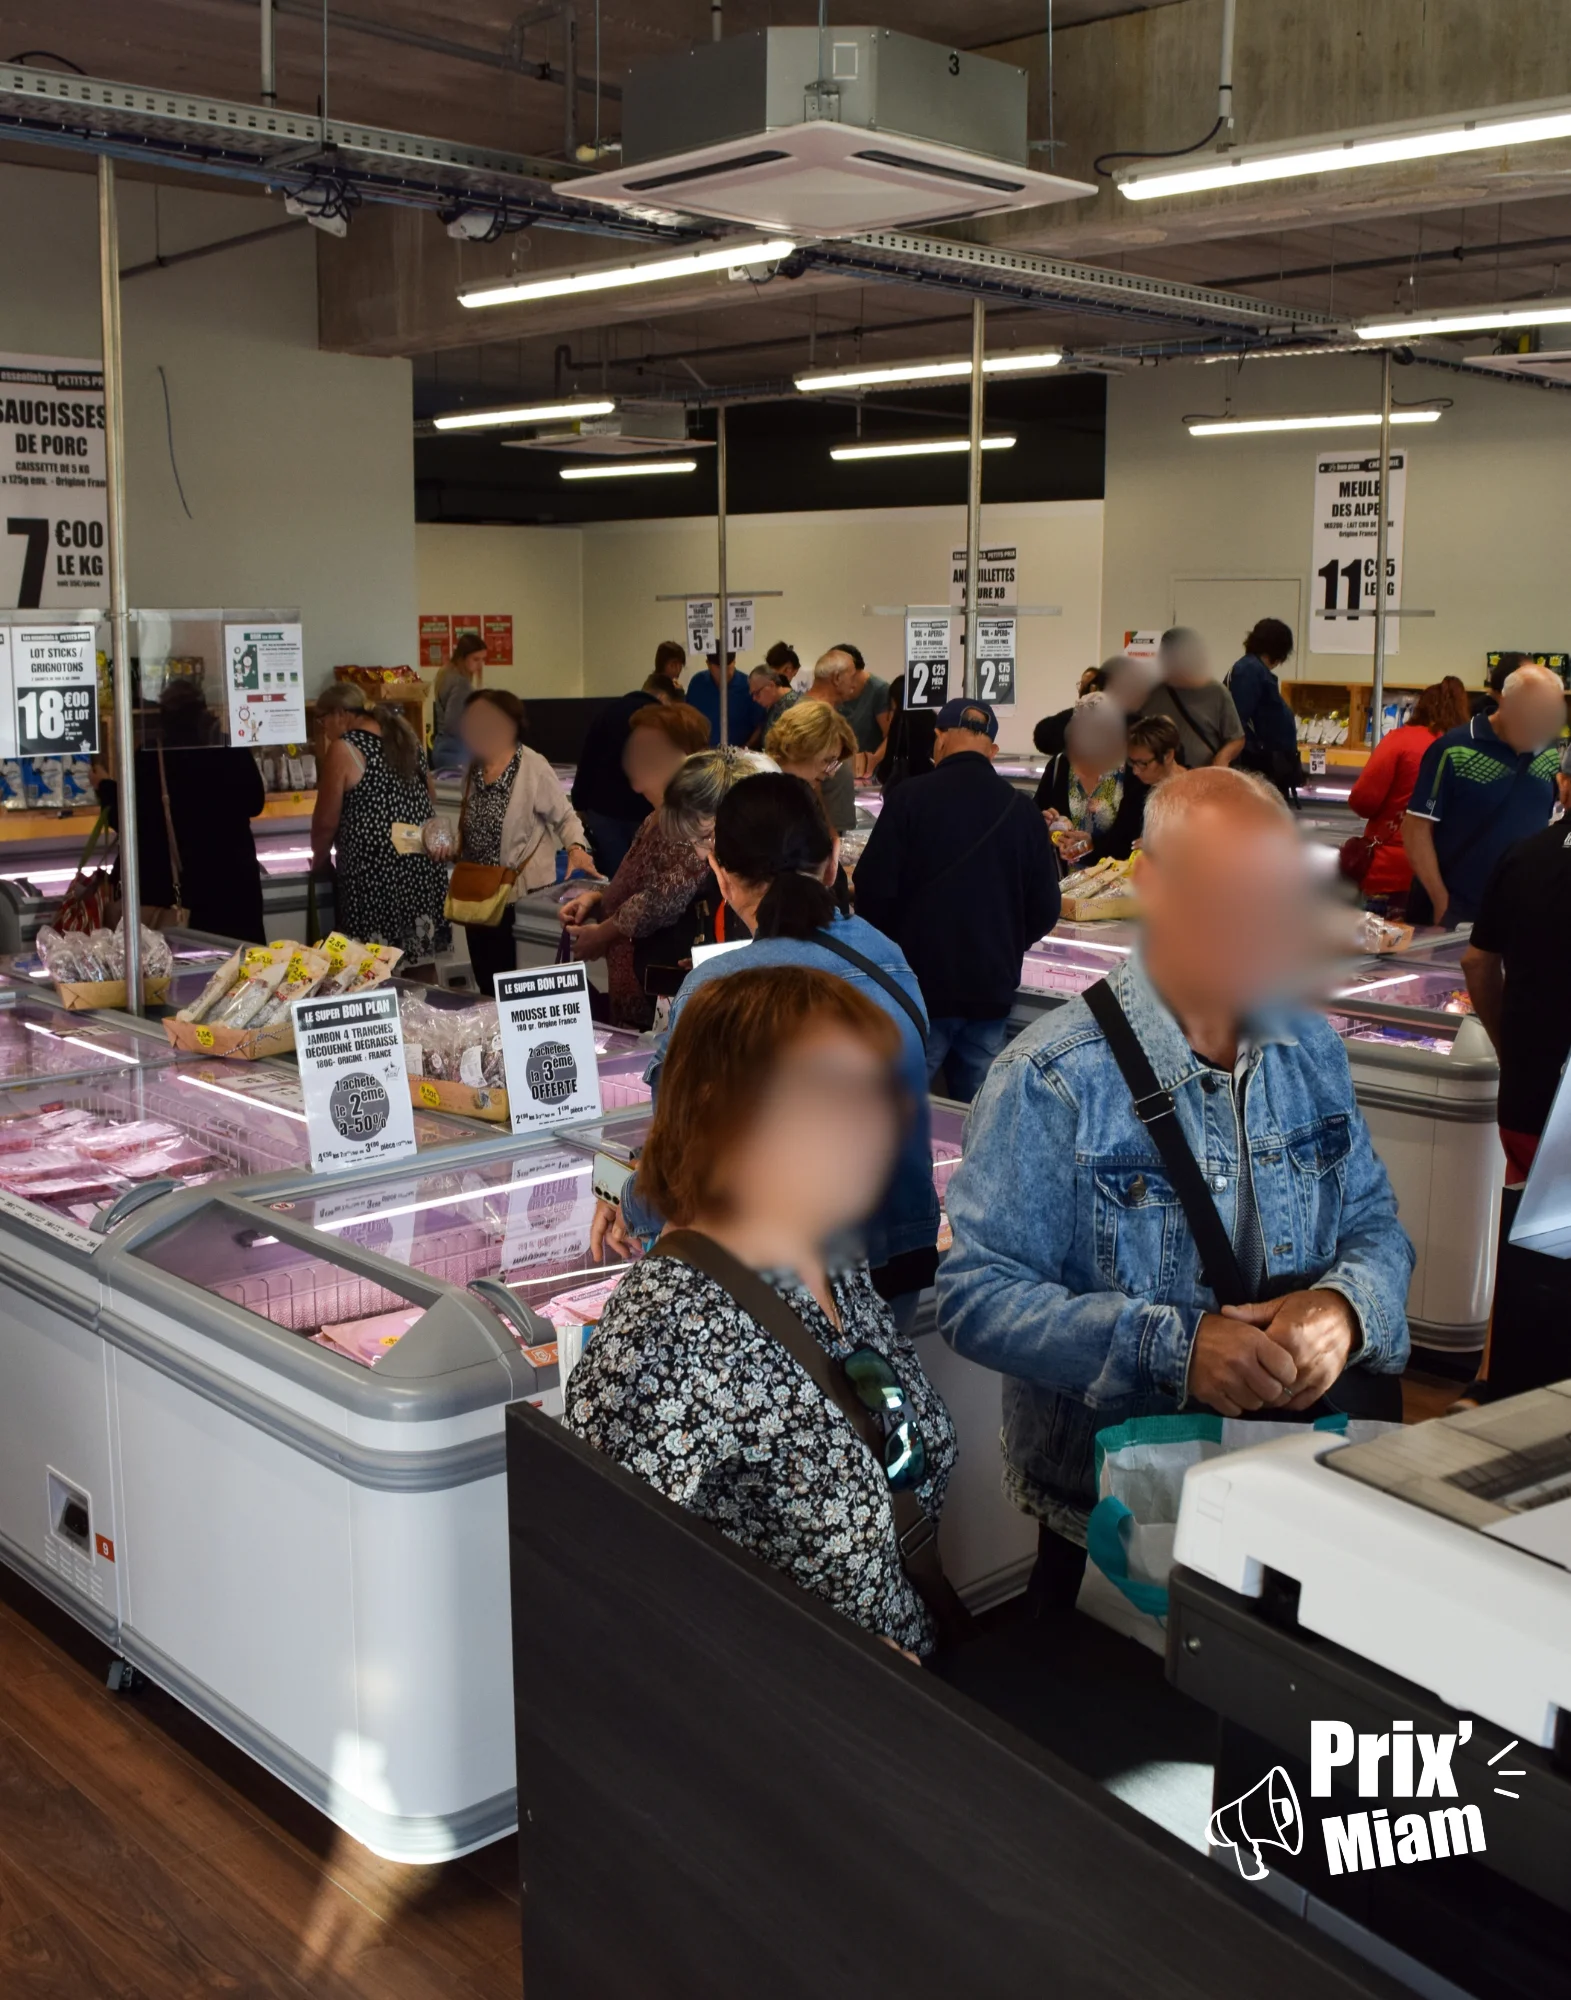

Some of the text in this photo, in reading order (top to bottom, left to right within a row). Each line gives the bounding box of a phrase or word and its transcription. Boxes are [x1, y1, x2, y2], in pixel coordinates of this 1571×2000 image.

[949, 54, 960, 76] 3
[57, 375, 91, 386] PETITS
[92, 376, 104, 387] PR
[15, 433, 88, 457] DE PORC
[15, 461, 90, 474] CAISSETTE DE 5 KG
[8, 474, 29, 485] 125g
[55, 476, 86, 487] Origine
[87, 478, 107, 488] Fran
[1339, 480, 1380, 498] MEULE
[1331, 502, 1380, 517] DES ALPE
[1346, 521, 1357, 529] LAIT
[7, 517, 49, 609] 7
[57, 555, 103, 576] LE KG
[962, 587, 1005, 599] NURE X8
[1318, 558, 1395, 621] 11 €5
[1364, 582, 1376, 596] LE
[693, 629, 703, 651] 5
[731, 626, 743, 648] 11
[30, 648, 45, 659] LOT
[48, 648, 77, 658] STICKS
[31, 662, 83, 673] GRIGNOTONS
[912, 662, 946, 704] 2 €25
[980, 660, 1011, 700] 2 €75
[18, 690, 65, 740] 18
[64, 691, 89, 708] €00
[64, 709, 89, 721] LE LOT
[1311, 760, 1318, 771] 5
[504, 974, 579, 995] LE SUPER BON PLAN
[305, 999, 390, 1023] LE SUPER BON PLAN
[510, 1002, 580, 1023] MOUSSE DE FOIE
[517, 1023, 527, 1032] 180
[538, 1019, 557, 1029] Origine
[558, 1016, 577, 1026] France
[307, 1023, 394, 1046] JAMBON 4 TRANCHES
[337, 1053, 363, 1065] ORIGINE
[368, 1049, 392, 1060] FRANCE
[528, 1047, 534, 1057] 2
[335, 1074, 376, 1091] 1 acheté
[531, 1071, 540, 1082] la
[531, 1079, 578, 1100] OFFERTE
[335, 1105, 346, 1118] le
[339, 1113, 387, 1136] à-50%
